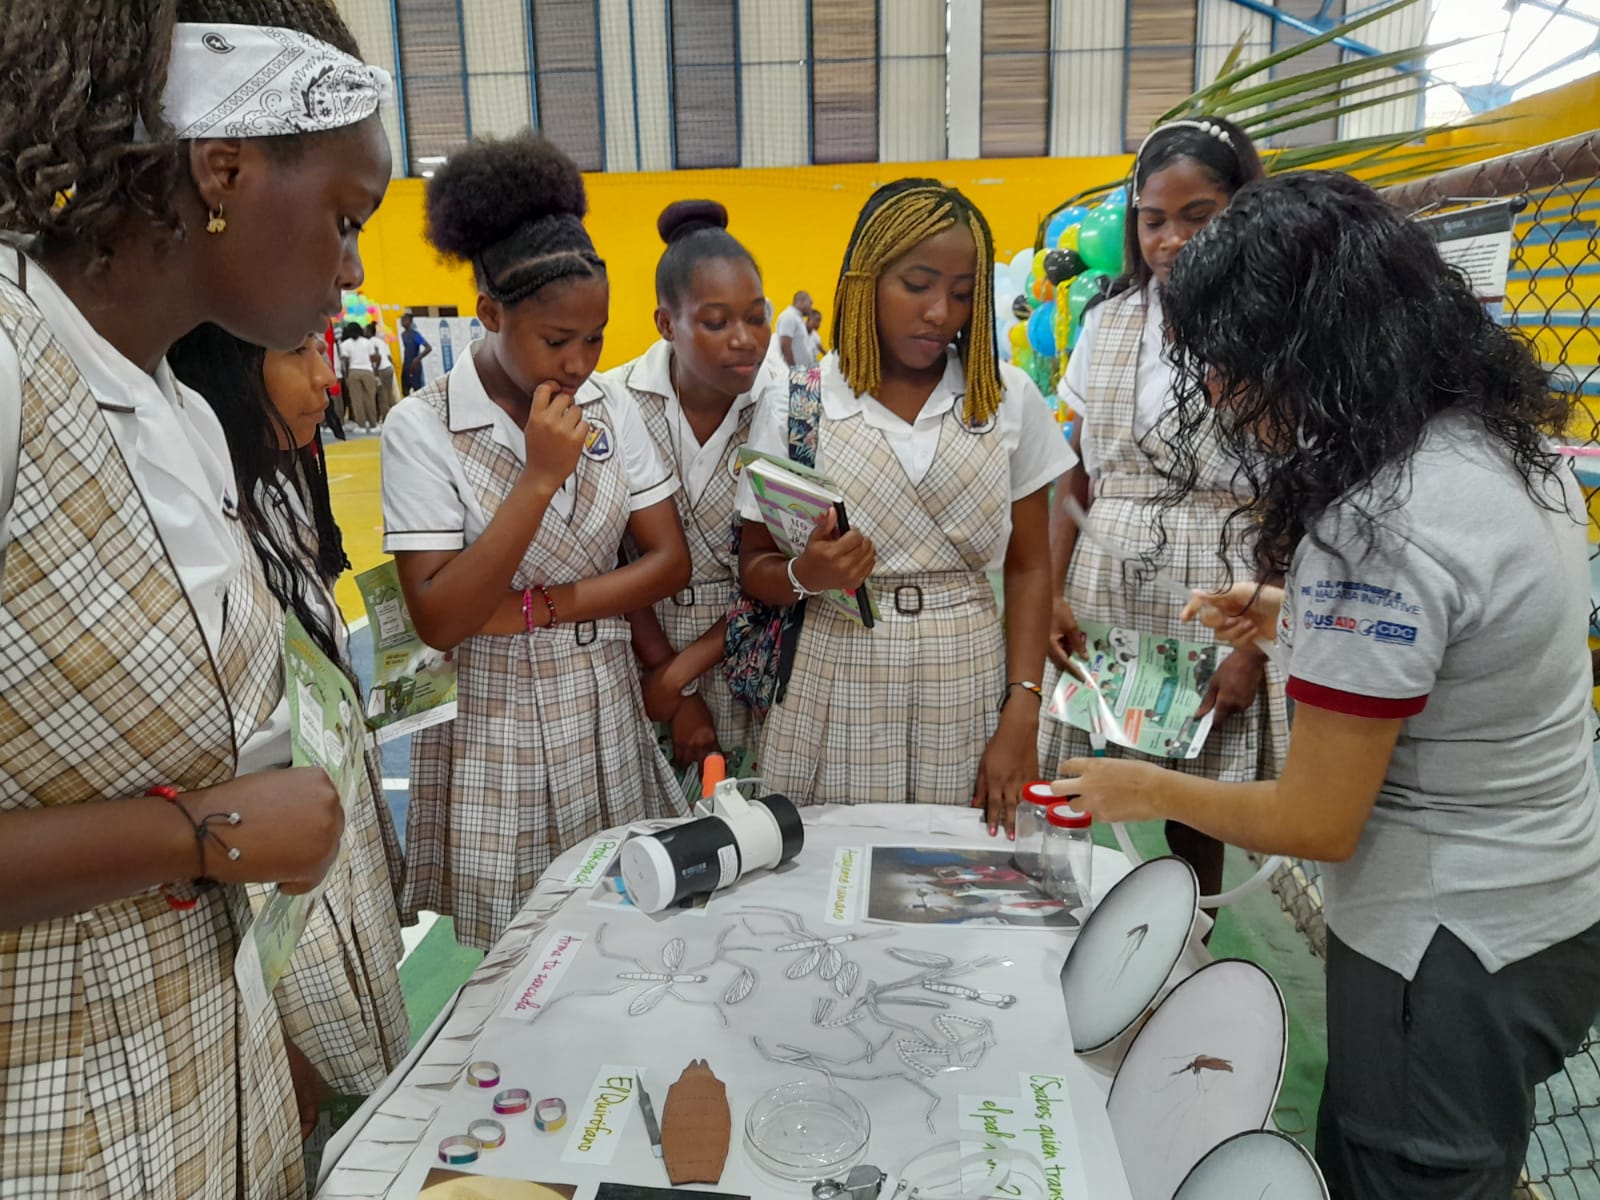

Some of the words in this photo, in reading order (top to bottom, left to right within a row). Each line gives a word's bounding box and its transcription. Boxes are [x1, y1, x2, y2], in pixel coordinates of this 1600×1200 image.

[1361, 592, 1422, 615] INITIATIVE
[1314, 614, 1357, 629] USAID
[1379, 623, 1413, 638] CDC
[598, 1077, 633, 1093] El
[978, 1101, 1014, 1114] el
